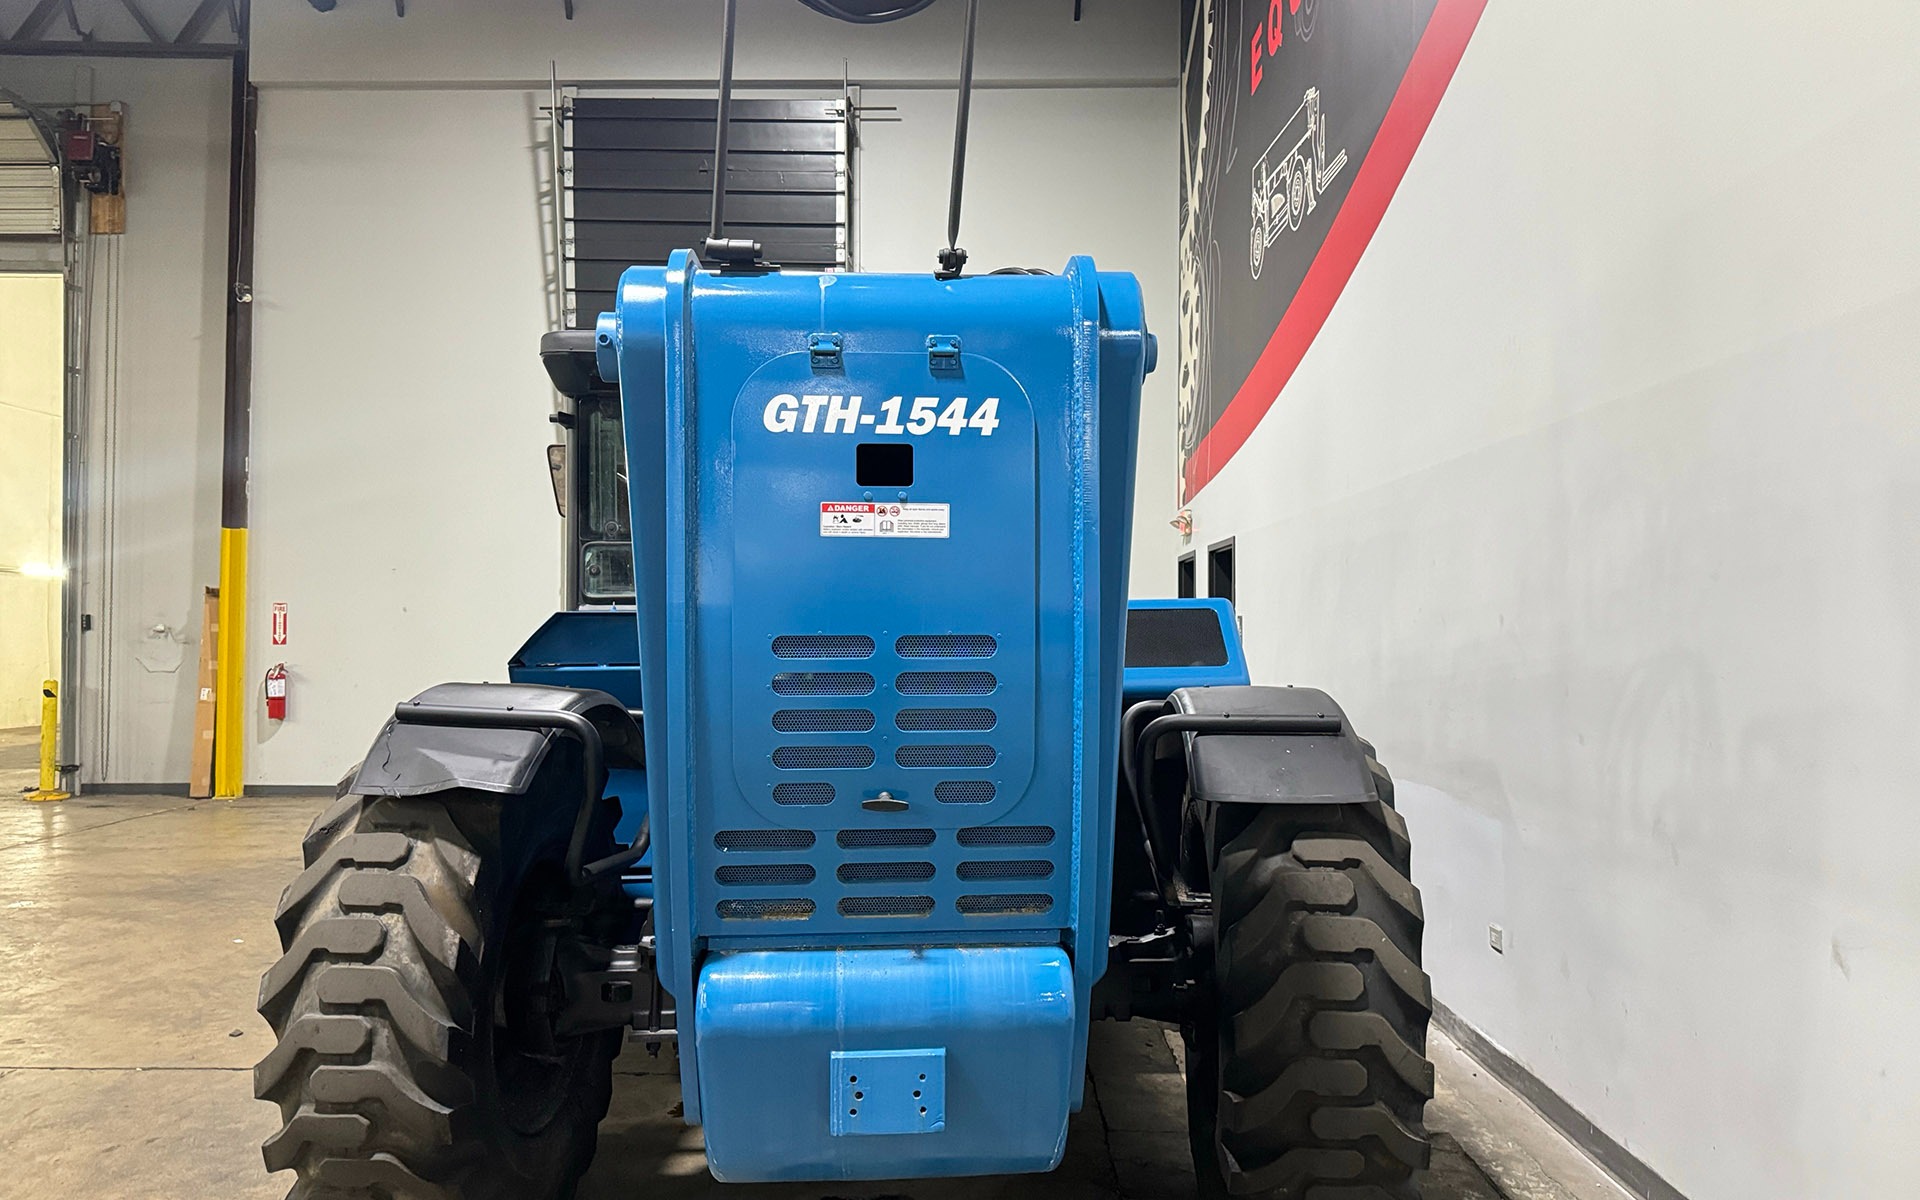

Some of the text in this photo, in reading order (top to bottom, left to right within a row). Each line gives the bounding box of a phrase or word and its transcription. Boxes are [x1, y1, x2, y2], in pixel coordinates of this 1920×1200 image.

[1251, 0, 1301, 97] EQ
[763, 393, 1000, 436] GTH-1544
[834, 504, 870, 512] DANGER
